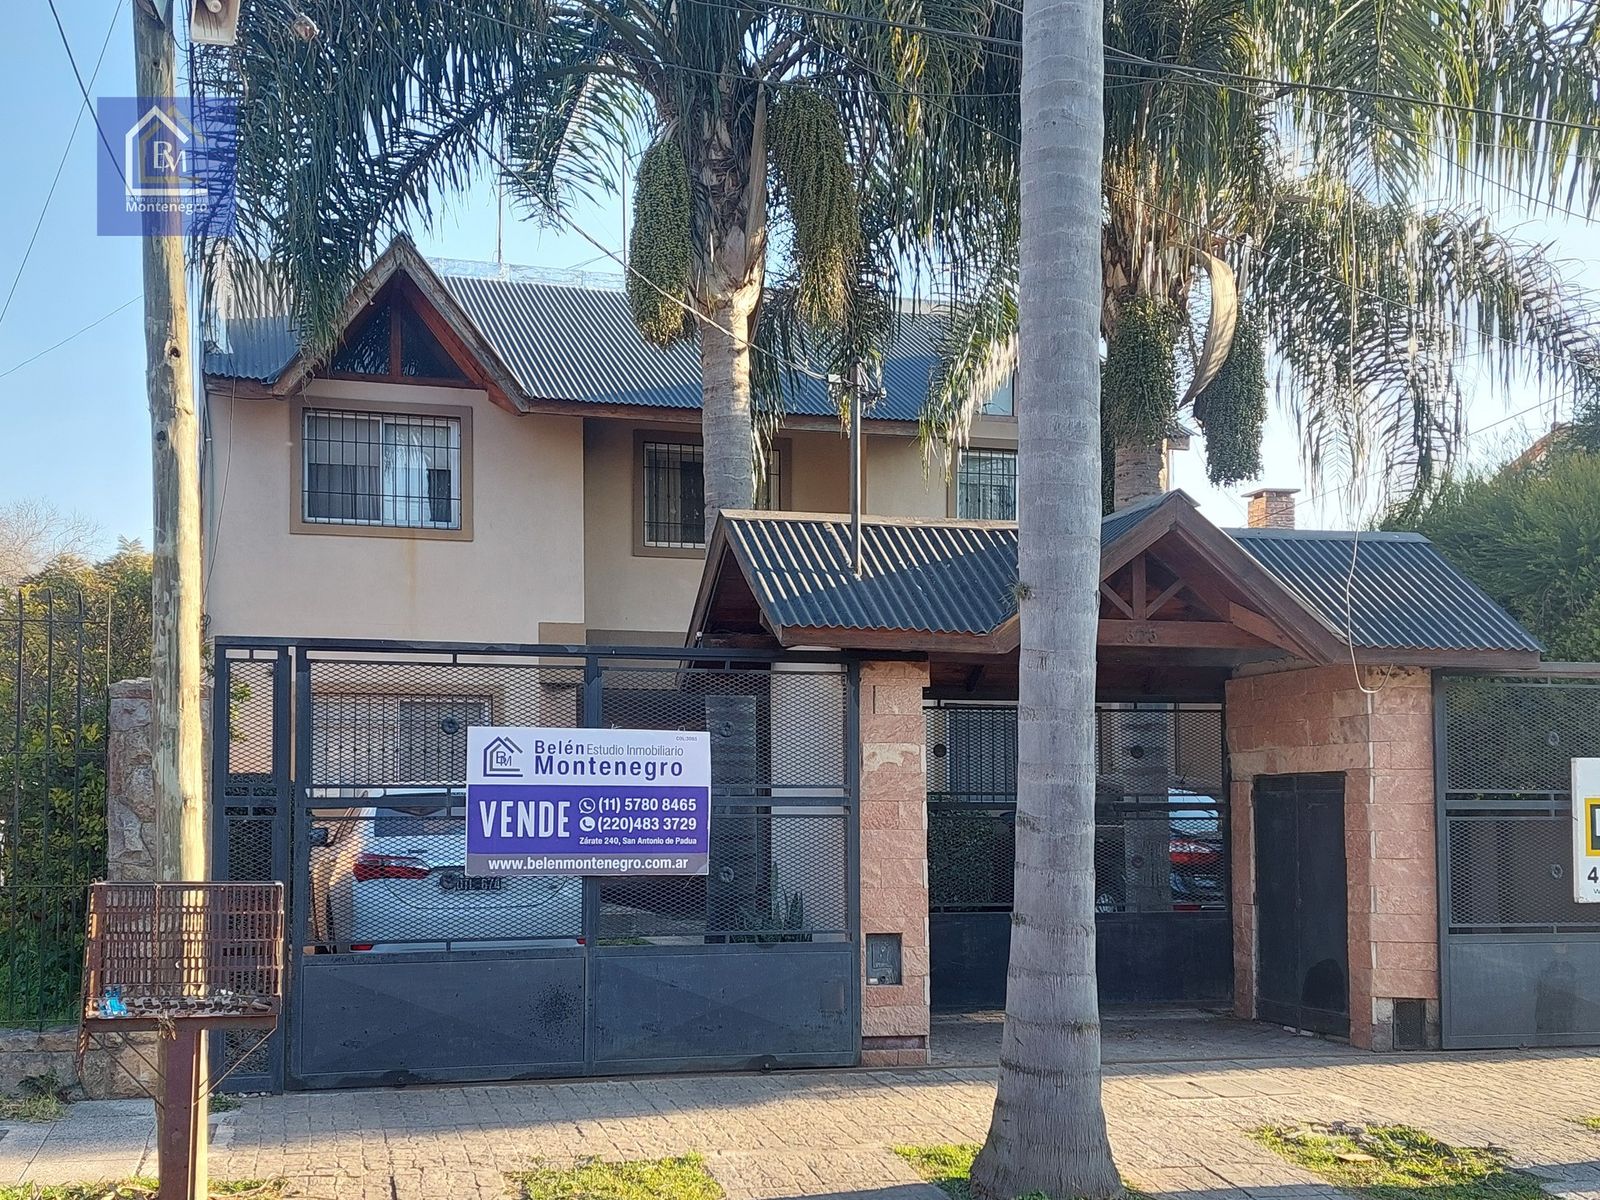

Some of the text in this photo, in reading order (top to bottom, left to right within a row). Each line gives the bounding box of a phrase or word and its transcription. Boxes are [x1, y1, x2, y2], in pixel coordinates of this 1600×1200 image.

[534, 738, 684, 757] Belén Estudio Inmobiliario
[535, 755, 683, 780] Montenegro
[598, 796, 697, 814] (11) 5780 8465
[479, 800, 571, 838] VENDE
[597, 816, 697, 834] (220)483 3729
[579, 836, 697, 846] Zárate 240, San Antonio de Padua
[488, 856, 689, 873] www.belenmontenegro.com.ar
